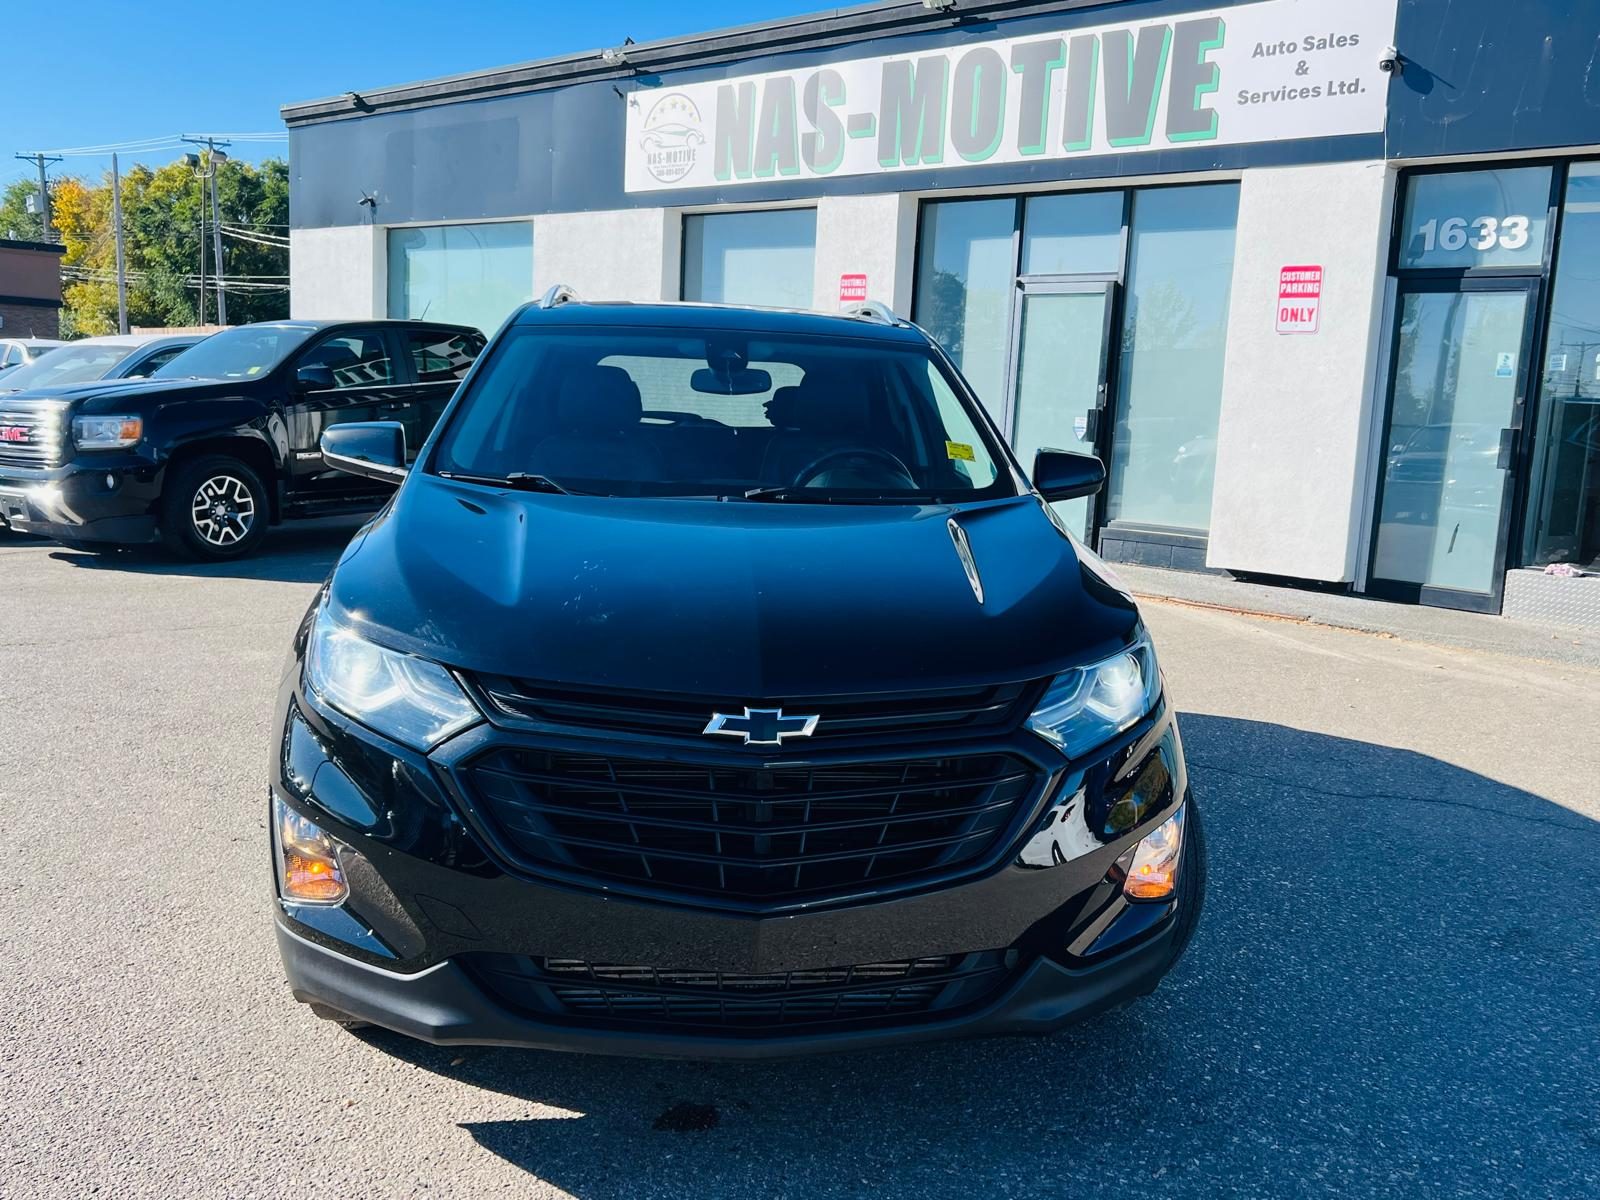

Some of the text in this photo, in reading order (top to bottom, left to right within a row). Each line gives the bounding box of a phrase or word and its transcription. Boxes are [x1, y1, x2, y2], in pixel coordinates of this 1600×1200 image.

[1251, 33, 1360, 58] Auto Sales
[1295, 60, 1309, 76] &
[714, 16, 1226, 182] NAS-MOTIVE
[1237, 78, 1366, 105] Services Ltd.
[647, 148, 696, 165] NAS-MOTIVE
[1419, 214, 1530, 251] 1633
[1281, 271, 1320, 281] CUSTOMER
[1280, 283, 1320, 293] PARKING
[1280, 307, 1315, 322] ONLY
